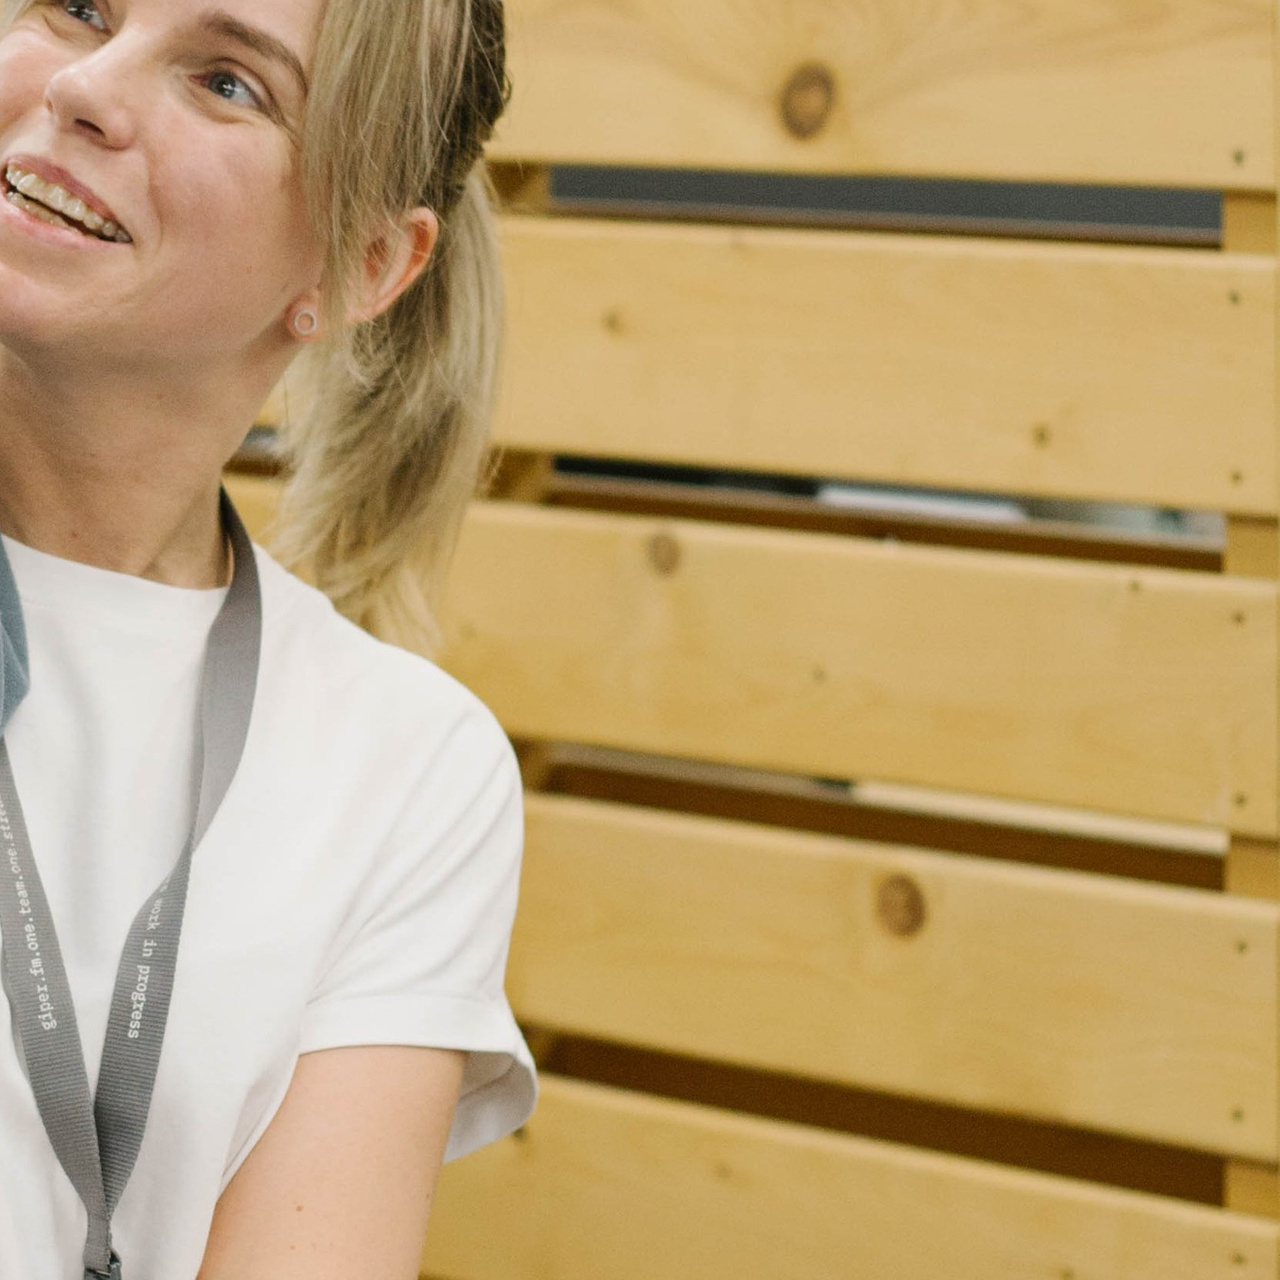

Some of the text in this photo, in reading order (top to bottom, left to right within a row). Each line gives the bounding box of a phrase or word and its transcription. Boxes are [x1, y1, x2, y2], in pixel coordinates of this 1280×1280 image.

[127, 898, 163, 1039] work in progress
